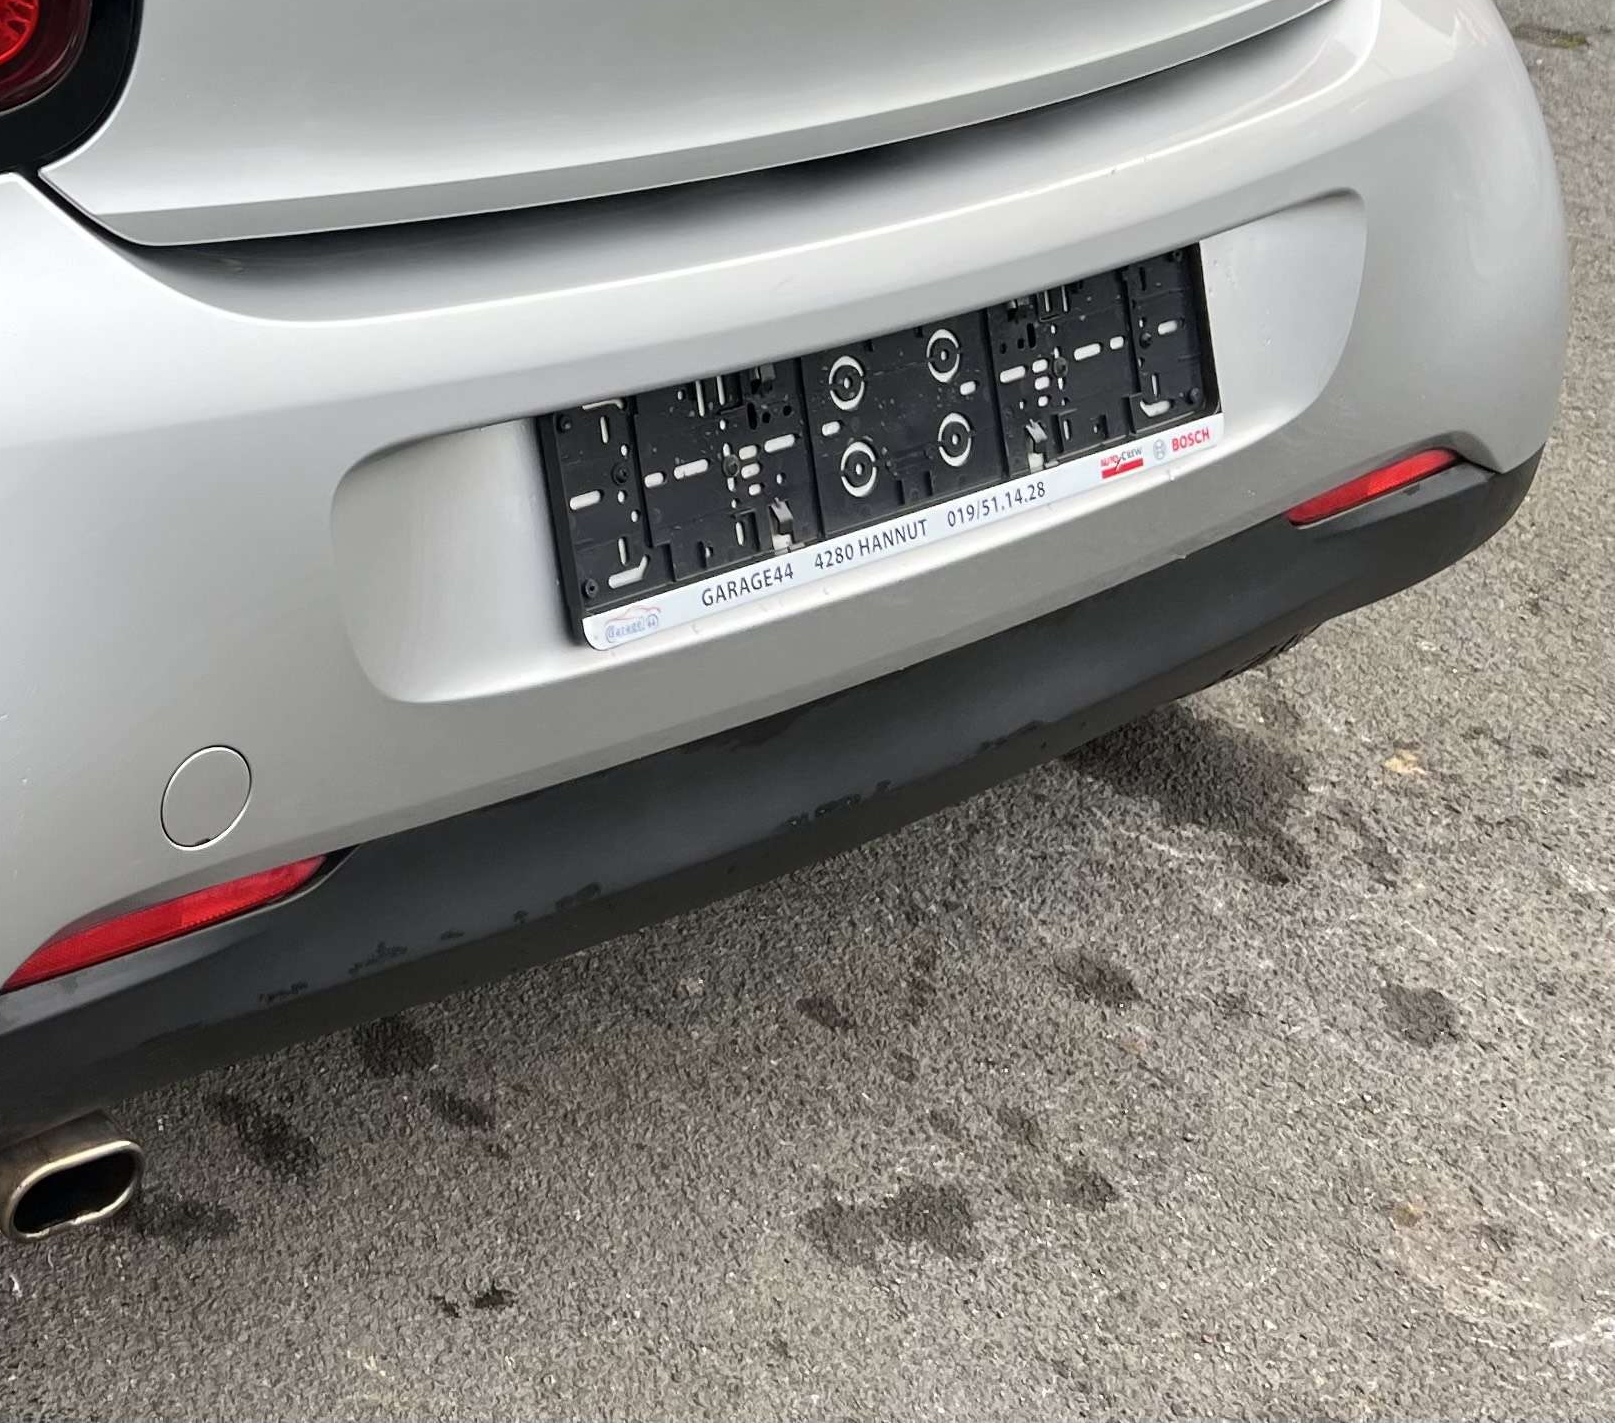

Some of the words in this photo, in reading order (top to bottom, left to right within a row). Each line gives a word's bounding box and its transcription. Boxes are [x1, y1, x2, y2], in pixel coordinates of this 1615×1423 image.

[1171, 426, 1211, 452] BOSCH
[700, 562, 795, 607] GARAGE44
[813, 543, 855, 570] 4280
[858, 518, 929, 557] HANNUT
[946, 481, 1047, 528] 019/51.14.28
